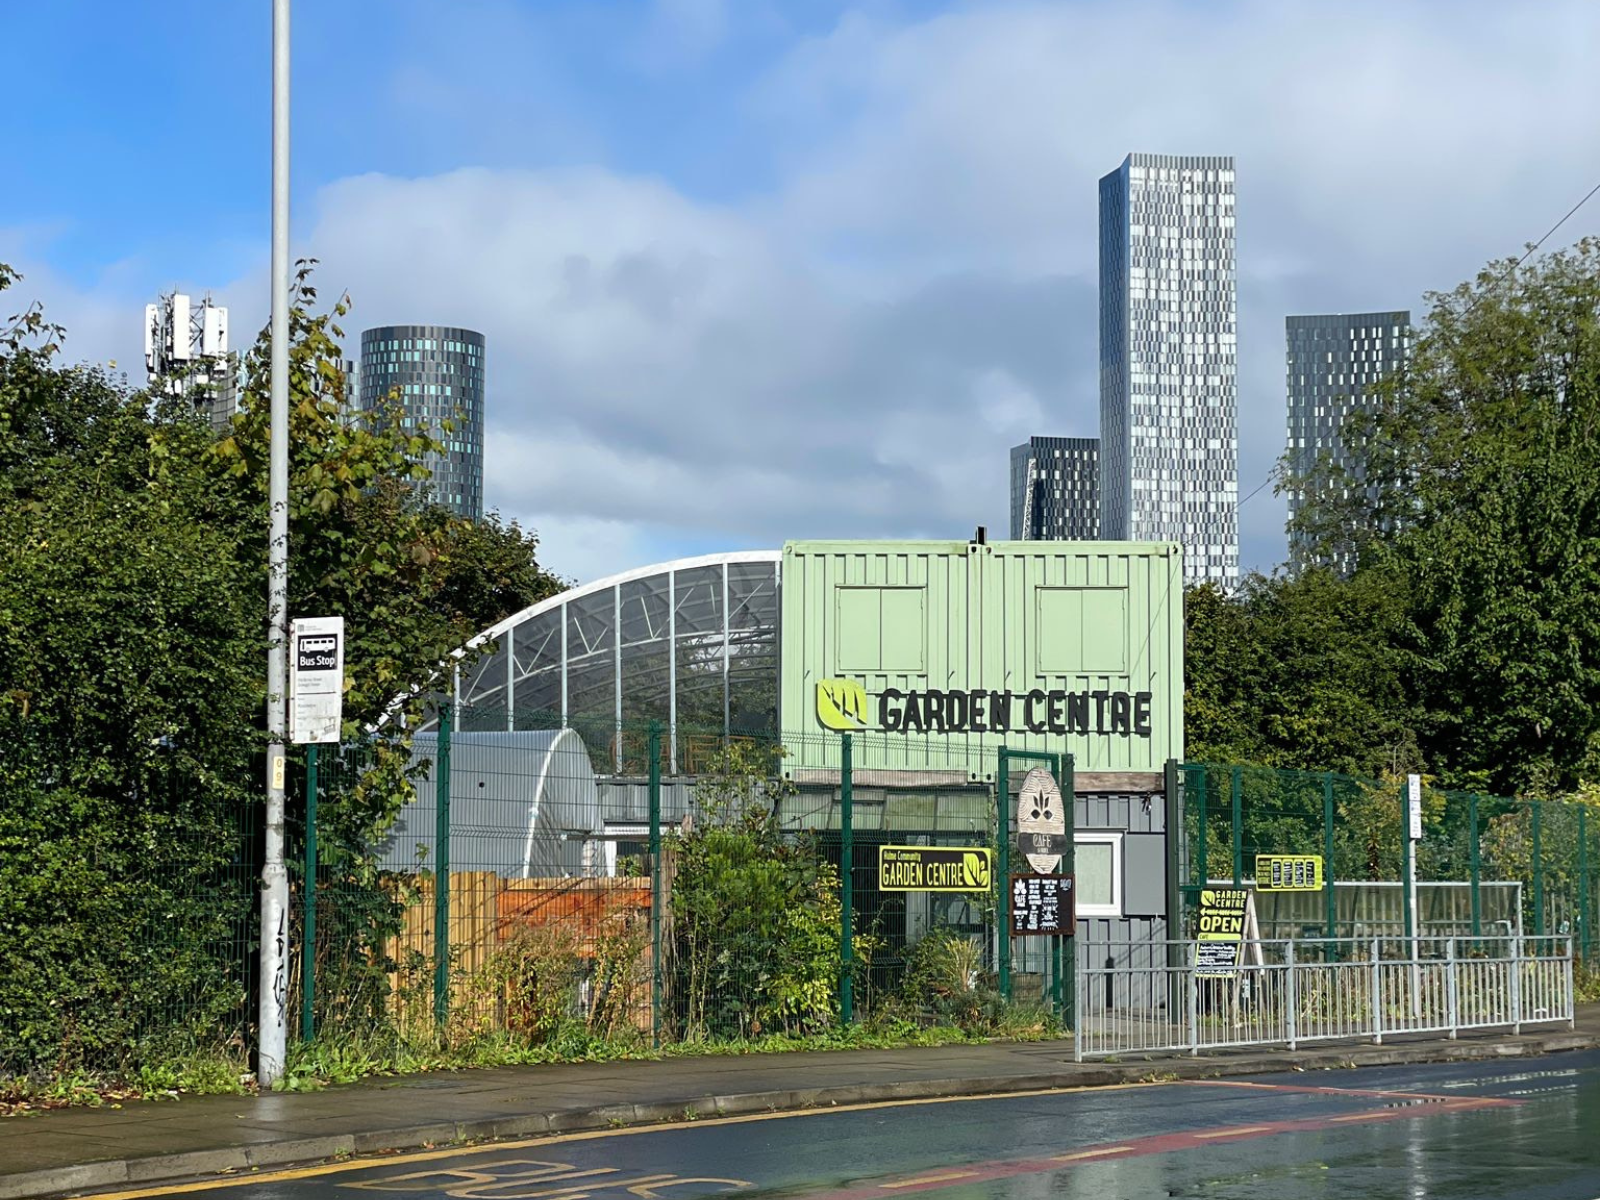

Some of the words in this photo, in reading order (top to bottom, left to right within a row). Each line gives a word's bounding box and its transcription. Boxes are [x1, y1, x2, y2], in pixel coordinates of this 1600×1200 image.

[300, 656, 315, 666] Bus
[316, 655, 335, 667] Stop
[879, 688, 1011, 734] GARDEN
[1025, 689, 1152, 736] CENTRE
[1033, 833, 1052, 847] CAFE
[882, 862, 922, 885] GARDEN
[926, 863, 963, 885] CENTRE
[1215, 890, 1247, 899] GARDEN
[1215, 899, 1245, 908] CENTRE
[1200, 916, 1242, 932] OPEN
